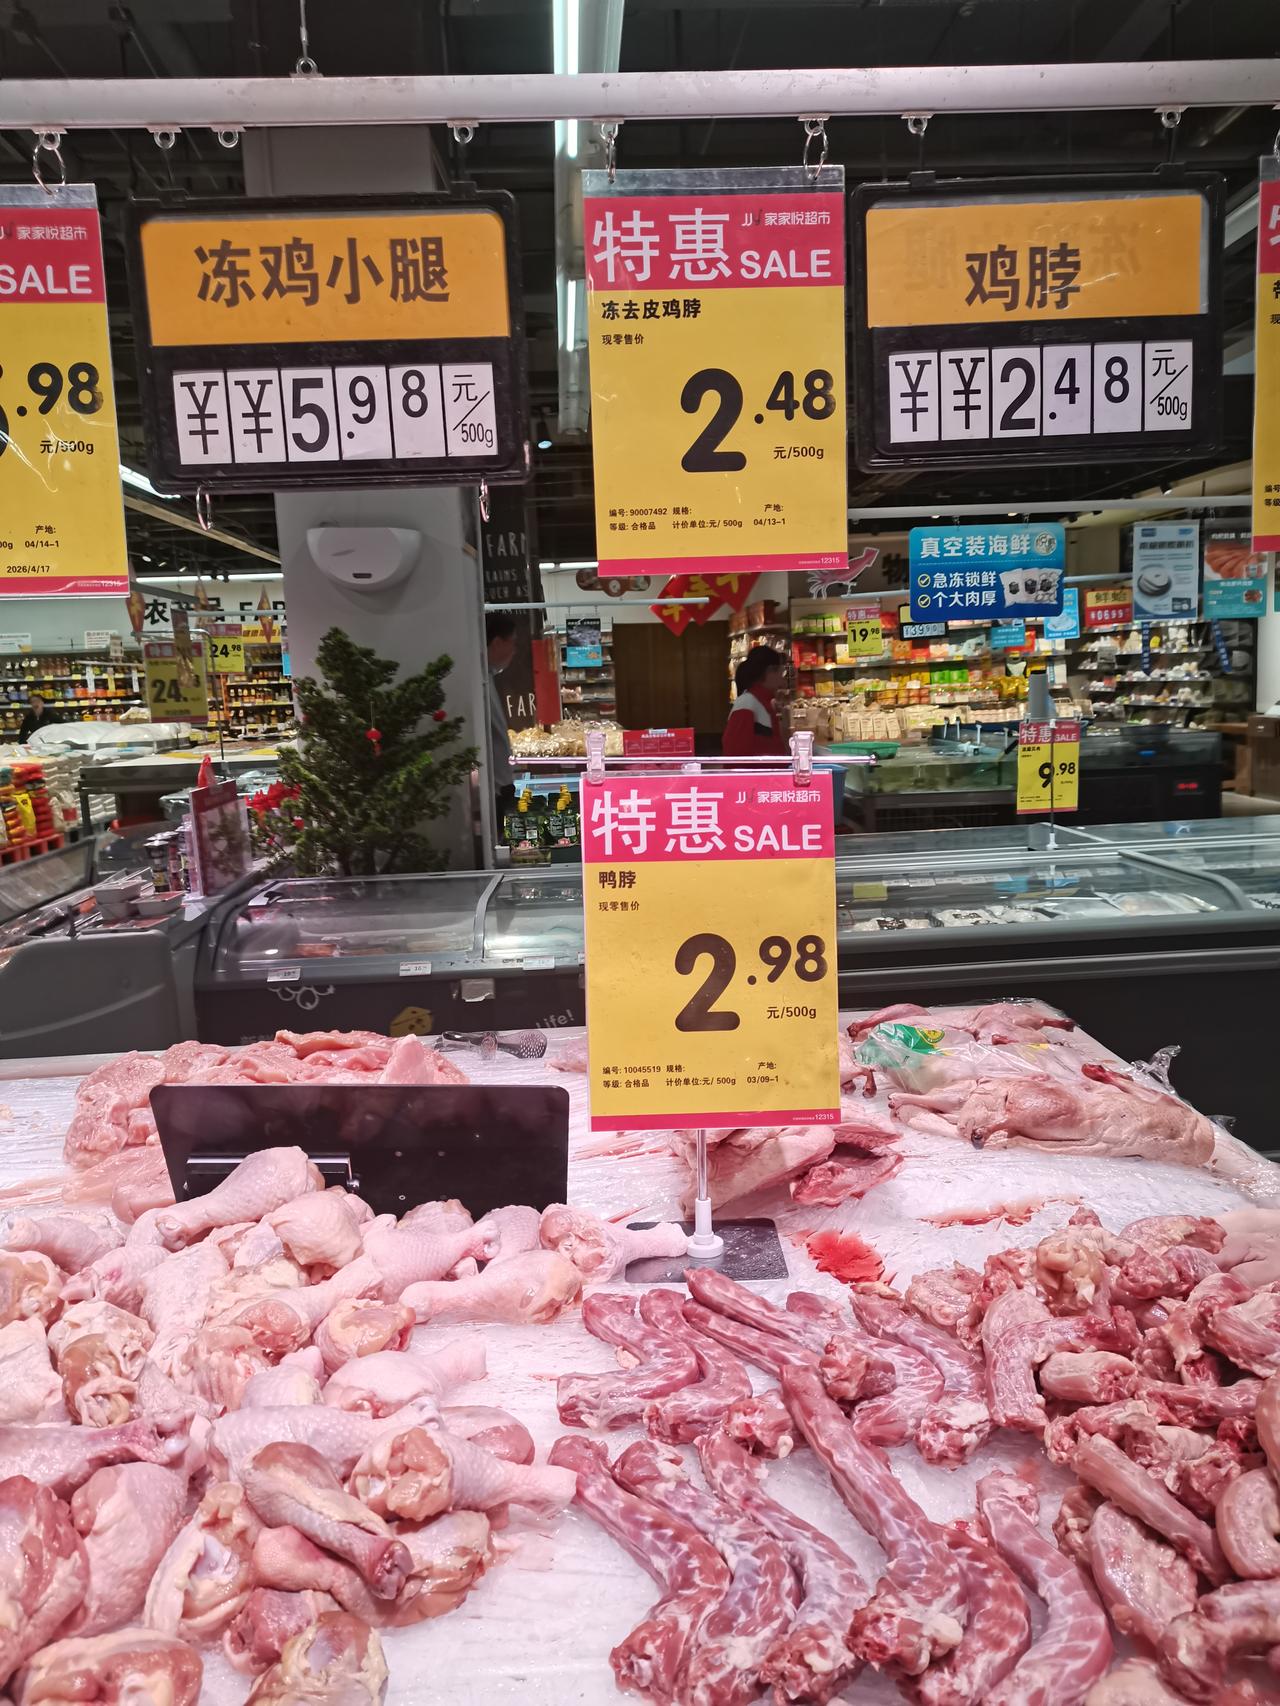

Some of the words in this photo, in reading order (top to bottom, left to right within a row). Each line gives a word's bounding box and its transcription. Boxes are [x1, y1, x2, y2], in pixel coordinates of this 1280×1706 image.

[764, 211, 831, 226] 家家悦超市
[17, 226, 88, 240] 家家悦超市
[593, 208, 732, 282] 特惠
[195, 236, 450, 307] 冻鸡小腿
[740, 249, 831, 279] SALE
[0, 264, 93, 295] SALE
[965, 242, 1081, 311] 鸡脖
[601, 298, 701, 320] 冻去皮鸡脖
[601, 333, 644, 345] 现零售价
[1150, 349, 1189, 421] 元/500g
[452, 374, 494, 448] 元/500g
[681, 368, 836, 473] 2.48
[773, 446, 824, 460] 元/500g
[608, 508, 629, 517] 编号:
[629, 507, 668, 517] 90007492
[672, 506, 692, 515] 规格:
[764, 503, 784, 513] 产地:
[35, 525, 57, 535] 产地:
[631, 521, 656, 531] 合格品
[723, 519, 743, 528] 500g
[753, 517, 786, 527] 04/13-1
[24, 540, 60, 549] 04/14-1
[920, 534, 1031, 559] 真空装海鲜
[6, 565, 50, 574] 2026/4/17
[820, 556, 840, 565] 12315
[932, 571, 997, 589] 急冻锁鲜
[932, 590, 997, 609] 个大肉厚
[1021, 725, 1052, 743] 特惠
[1038, 762, 1076, 789] 9.98
[757, 790, 821, 803] 家家悦超市
[591, 786, 727, 856] 特惠
[733, 824, 823, 852] SALE
[598, 870, 637, 889] 鸭脖
[598, 901, 640, 912] 现零售价
[674, 932, 828, 1033] 2.98
[766, 1005, 817, 1020] 元/500g
[602, 1066, 622, 1076] 编号:
[624, 1065, 661, 1075] 10045519
[666, 1064, 686, 1073] 规格:
[757, 1061, 777, 1071] 产地:
[602, 1080, 622, 1089] 等级:
[624, 1079, 650, 1088] 合格品
[716, 1076, 737, 1086] 500g
[747, 1075, 779, 1084] 03/09-1
[814, 1113, 834, 1121] 12315
